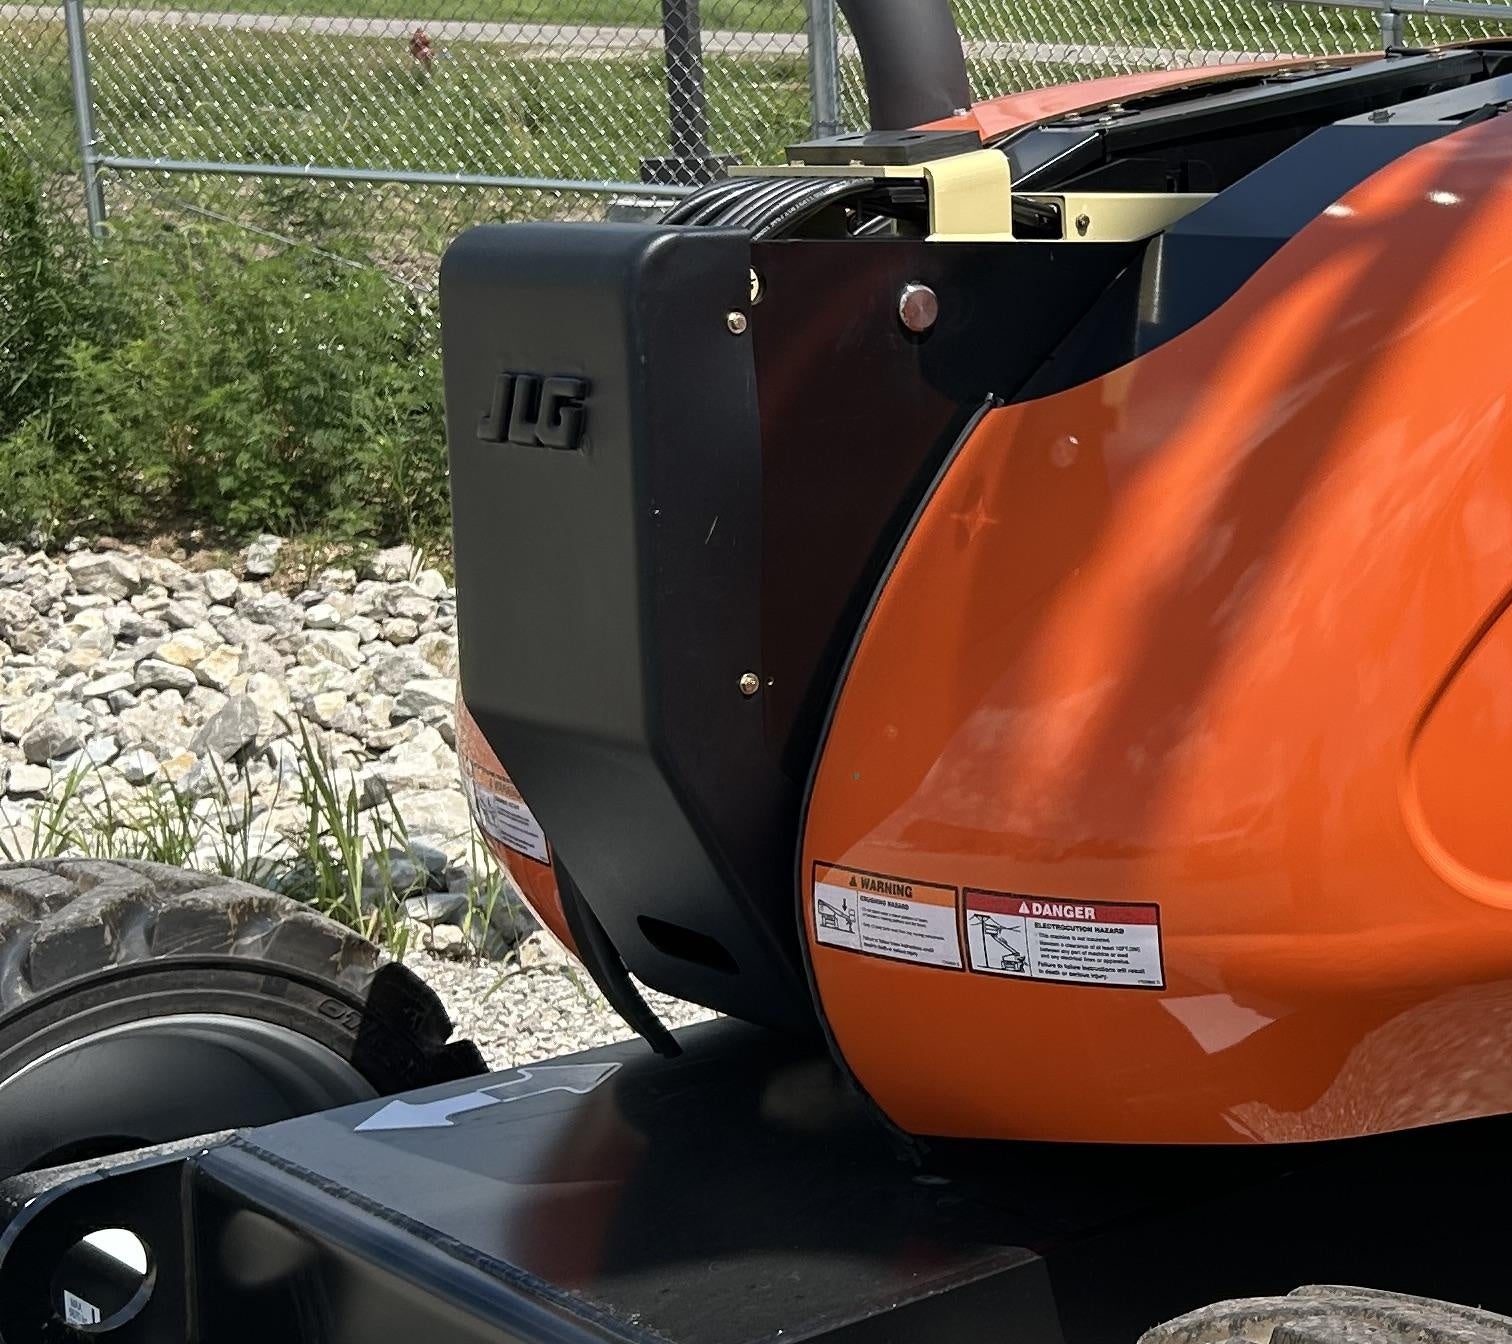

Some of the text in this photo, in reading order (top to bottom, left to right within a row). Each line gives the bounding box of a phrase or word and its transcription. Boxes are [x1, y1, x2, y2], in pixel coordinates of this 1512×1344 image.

[476, 372, 586, 451] JLG
[860, 876, 913, 898] WARNING
[1032, 902, 1096, 920] DANGER
[1034, 921, 1125, 935] ELECTROCUTION HAZARD
